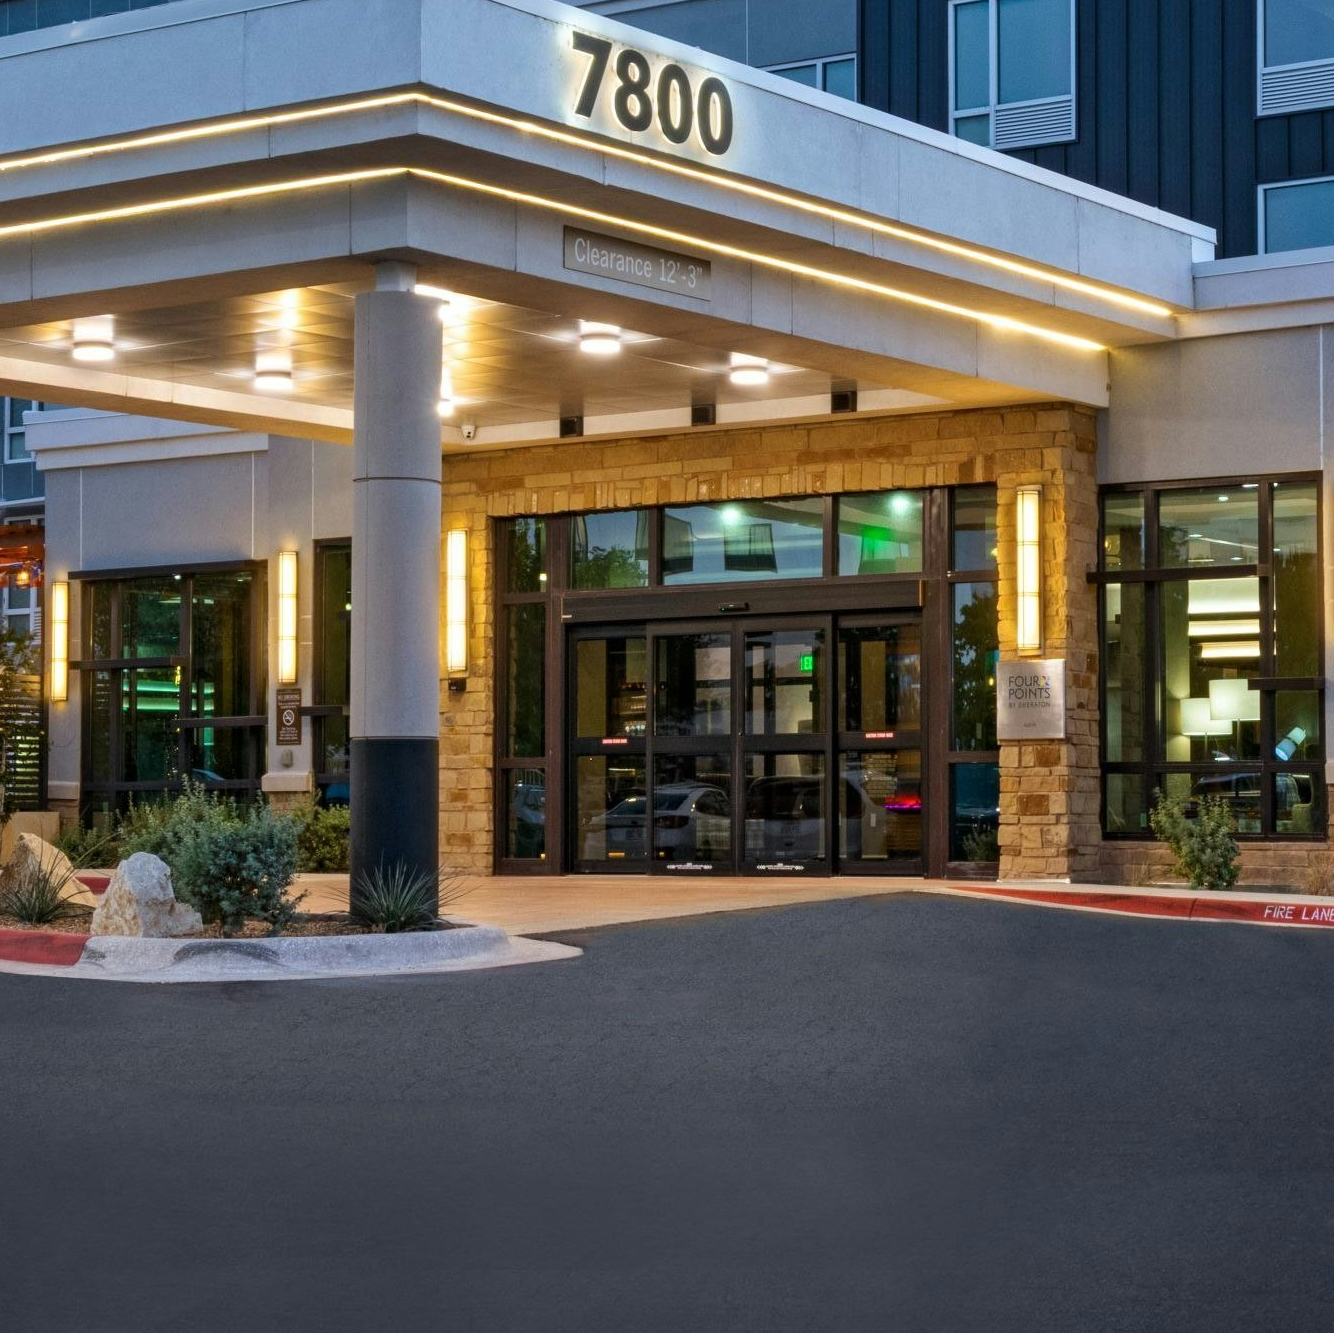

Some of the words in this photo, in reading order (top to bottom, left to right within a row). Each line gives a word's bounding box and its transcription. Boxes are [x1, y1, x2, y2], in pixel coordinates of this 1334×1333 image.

[572, 30, 734, 156] 7800
[574, 237, 652, 278] Clearance
[1008, 675, 1040, 687] FOUR
[1008, 688, 1051, 700] POINTS
[1263, 905, 1296, 920] FIRE
